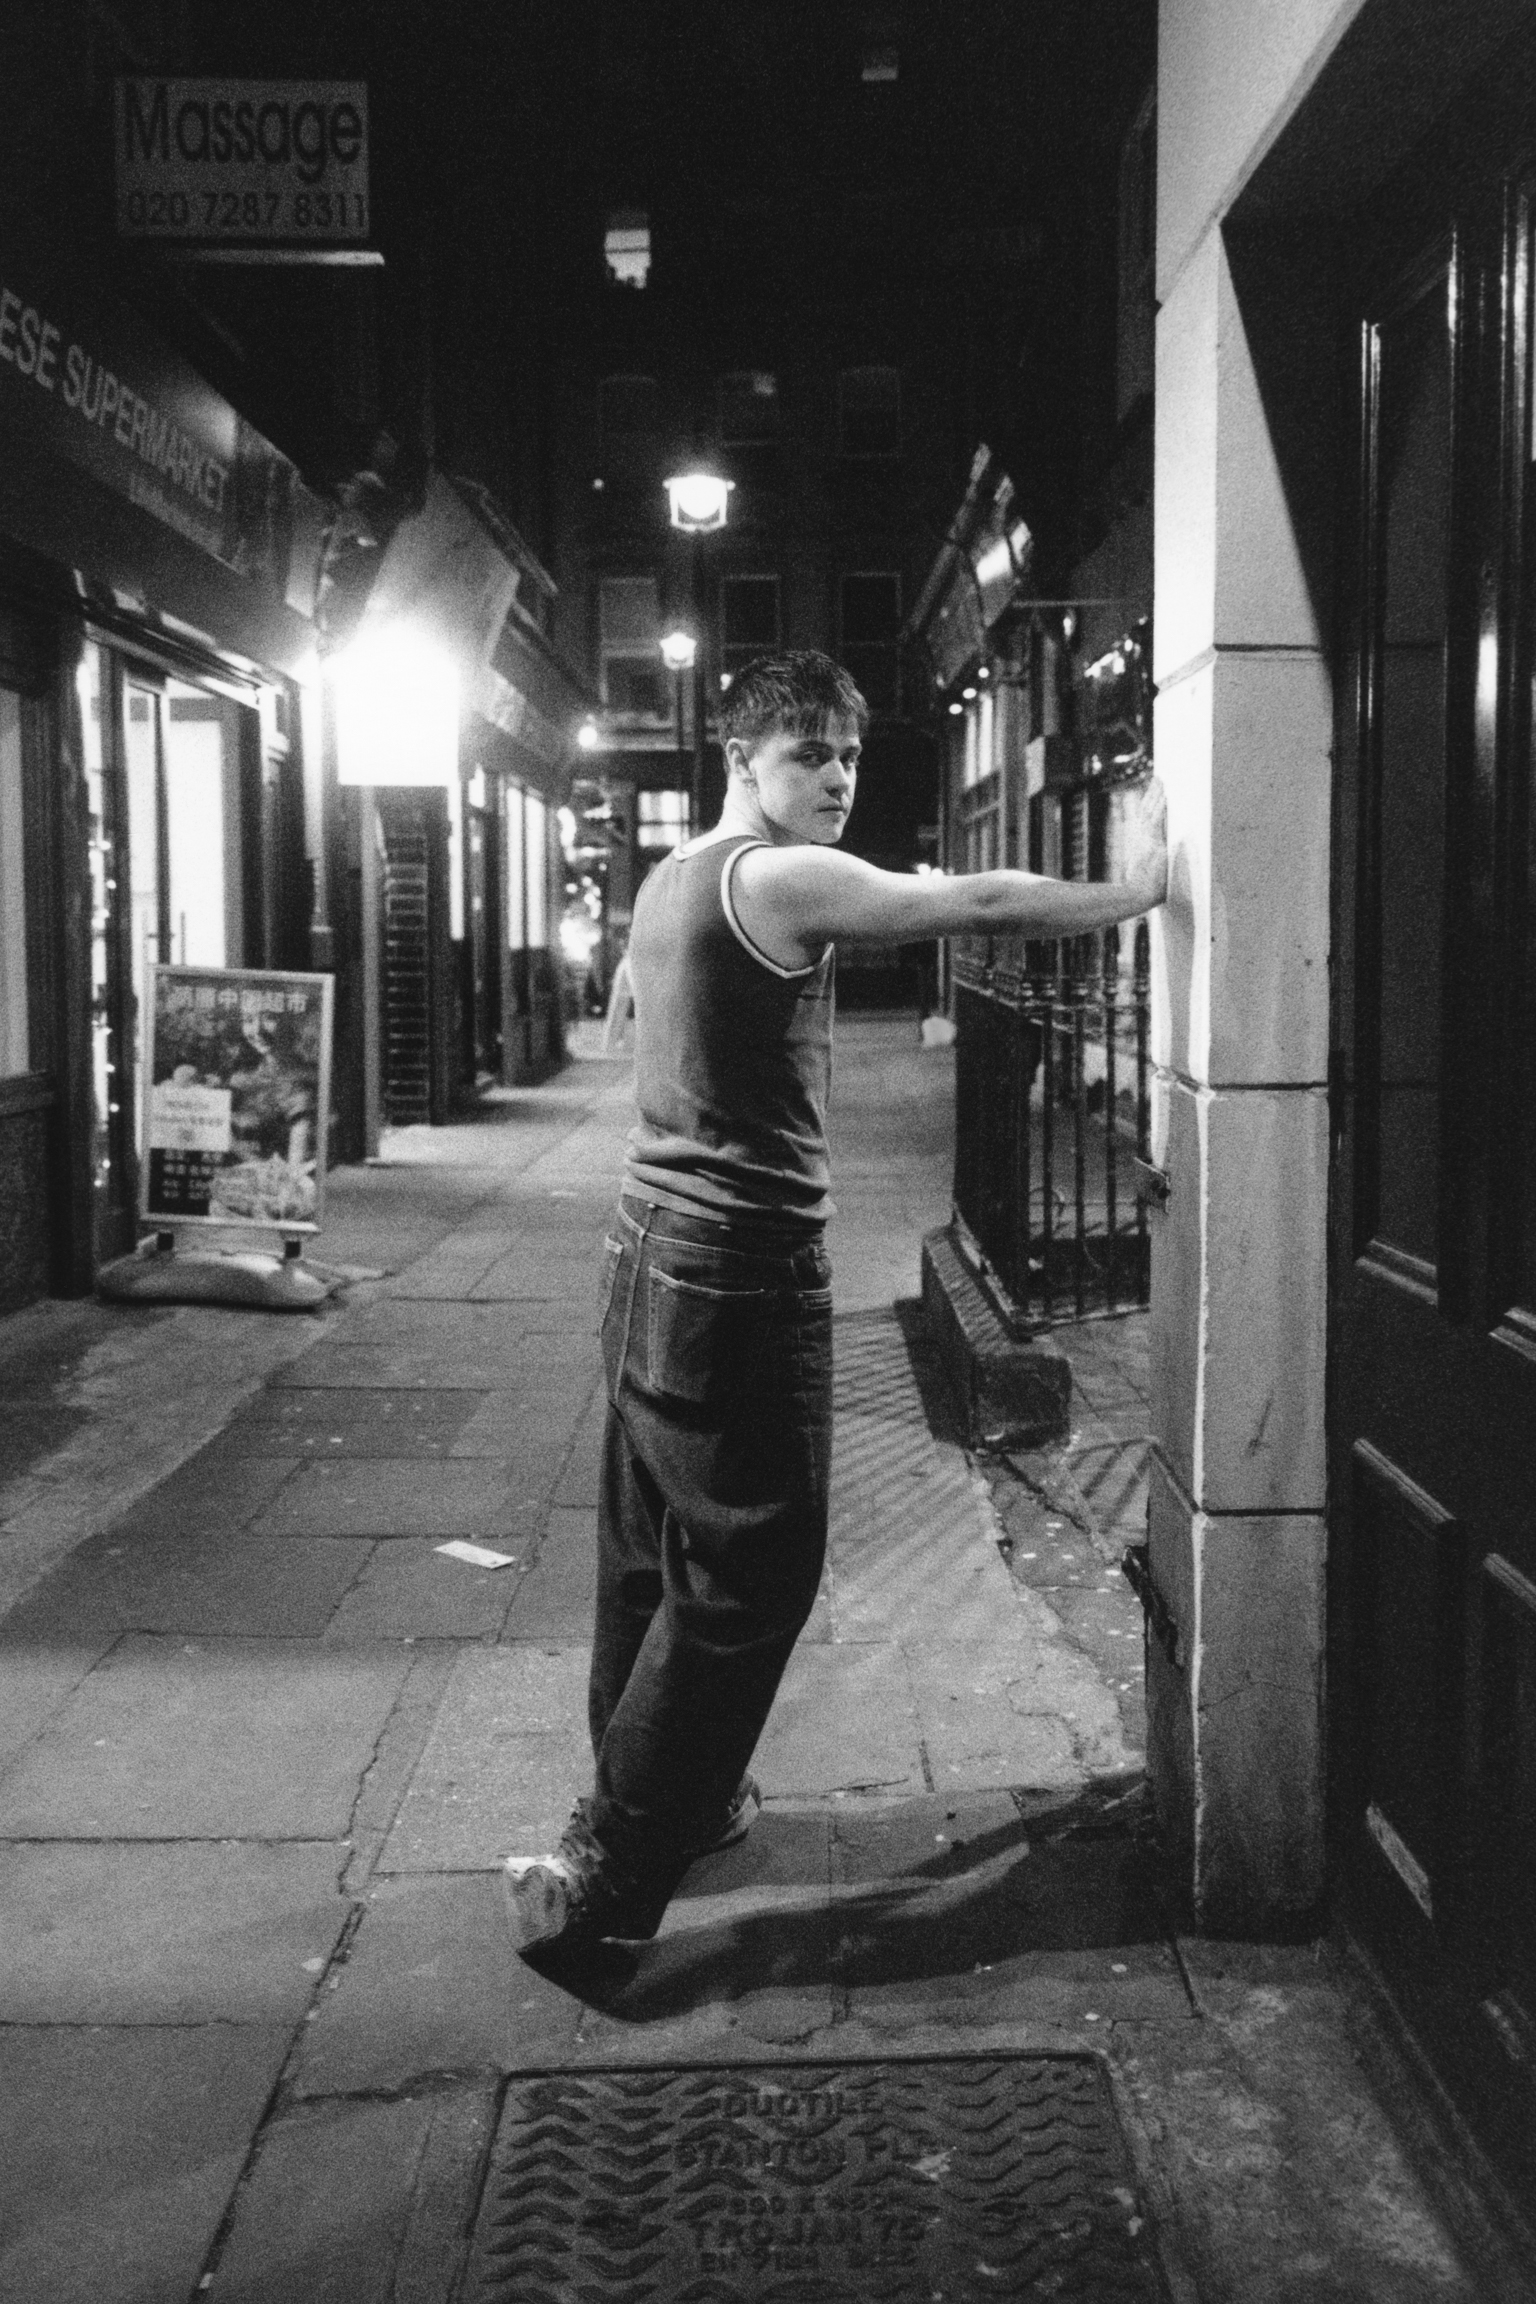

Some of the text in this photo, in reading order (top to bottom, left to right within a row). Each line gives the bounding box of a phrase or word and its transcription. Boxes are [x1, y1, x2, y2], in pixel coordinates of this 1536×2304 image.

[123, 83, 363, 183] Massage
[127, 191, 366, 228] 020 7287 8311
[62, 343, 229, 513] SUPERMARKET
[676, 2137, 848, 2169] STANTON
[688, 2216, 863, 2248] TROJAN
